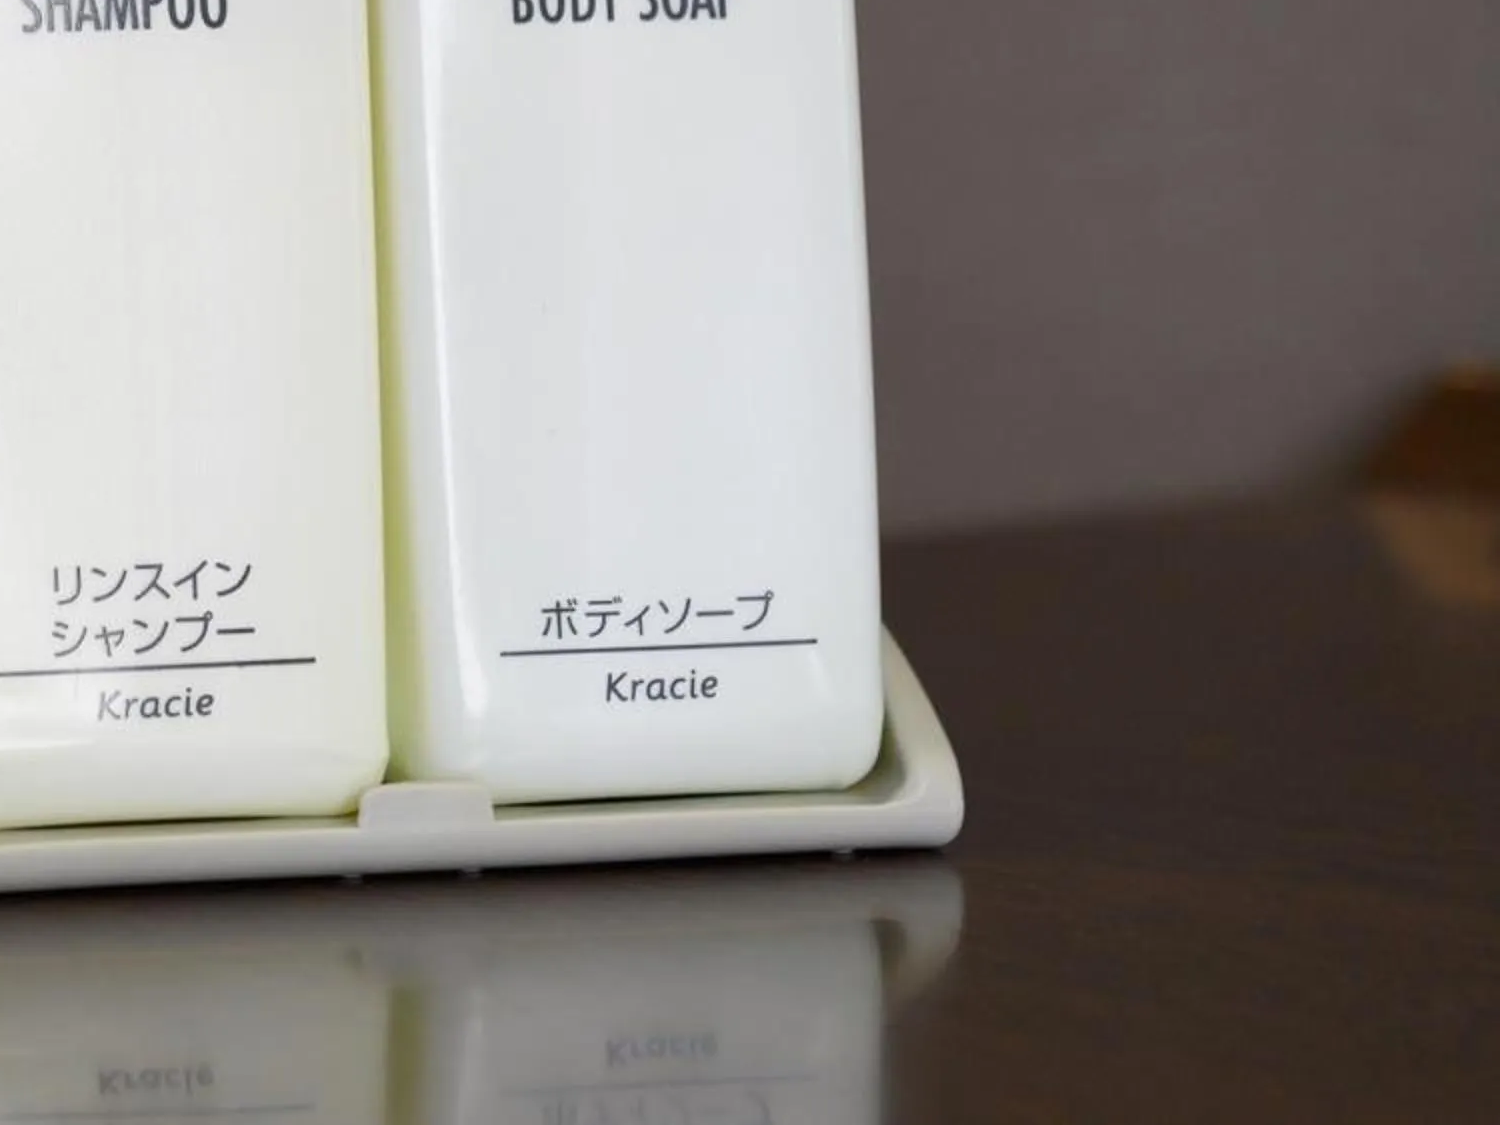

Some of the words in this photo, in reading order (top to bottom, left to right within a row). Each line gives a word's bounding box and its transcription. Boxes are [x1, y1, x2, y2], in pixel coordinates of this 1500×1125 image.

[51, 559, 254, 606] リンスイン
[50, 609, 257, 660] シャンプー
[539, 589, 776, 640] ボディソープ
[96, 686, 216, 722] Kracie
[604, 667, 719, 704] Kracie
